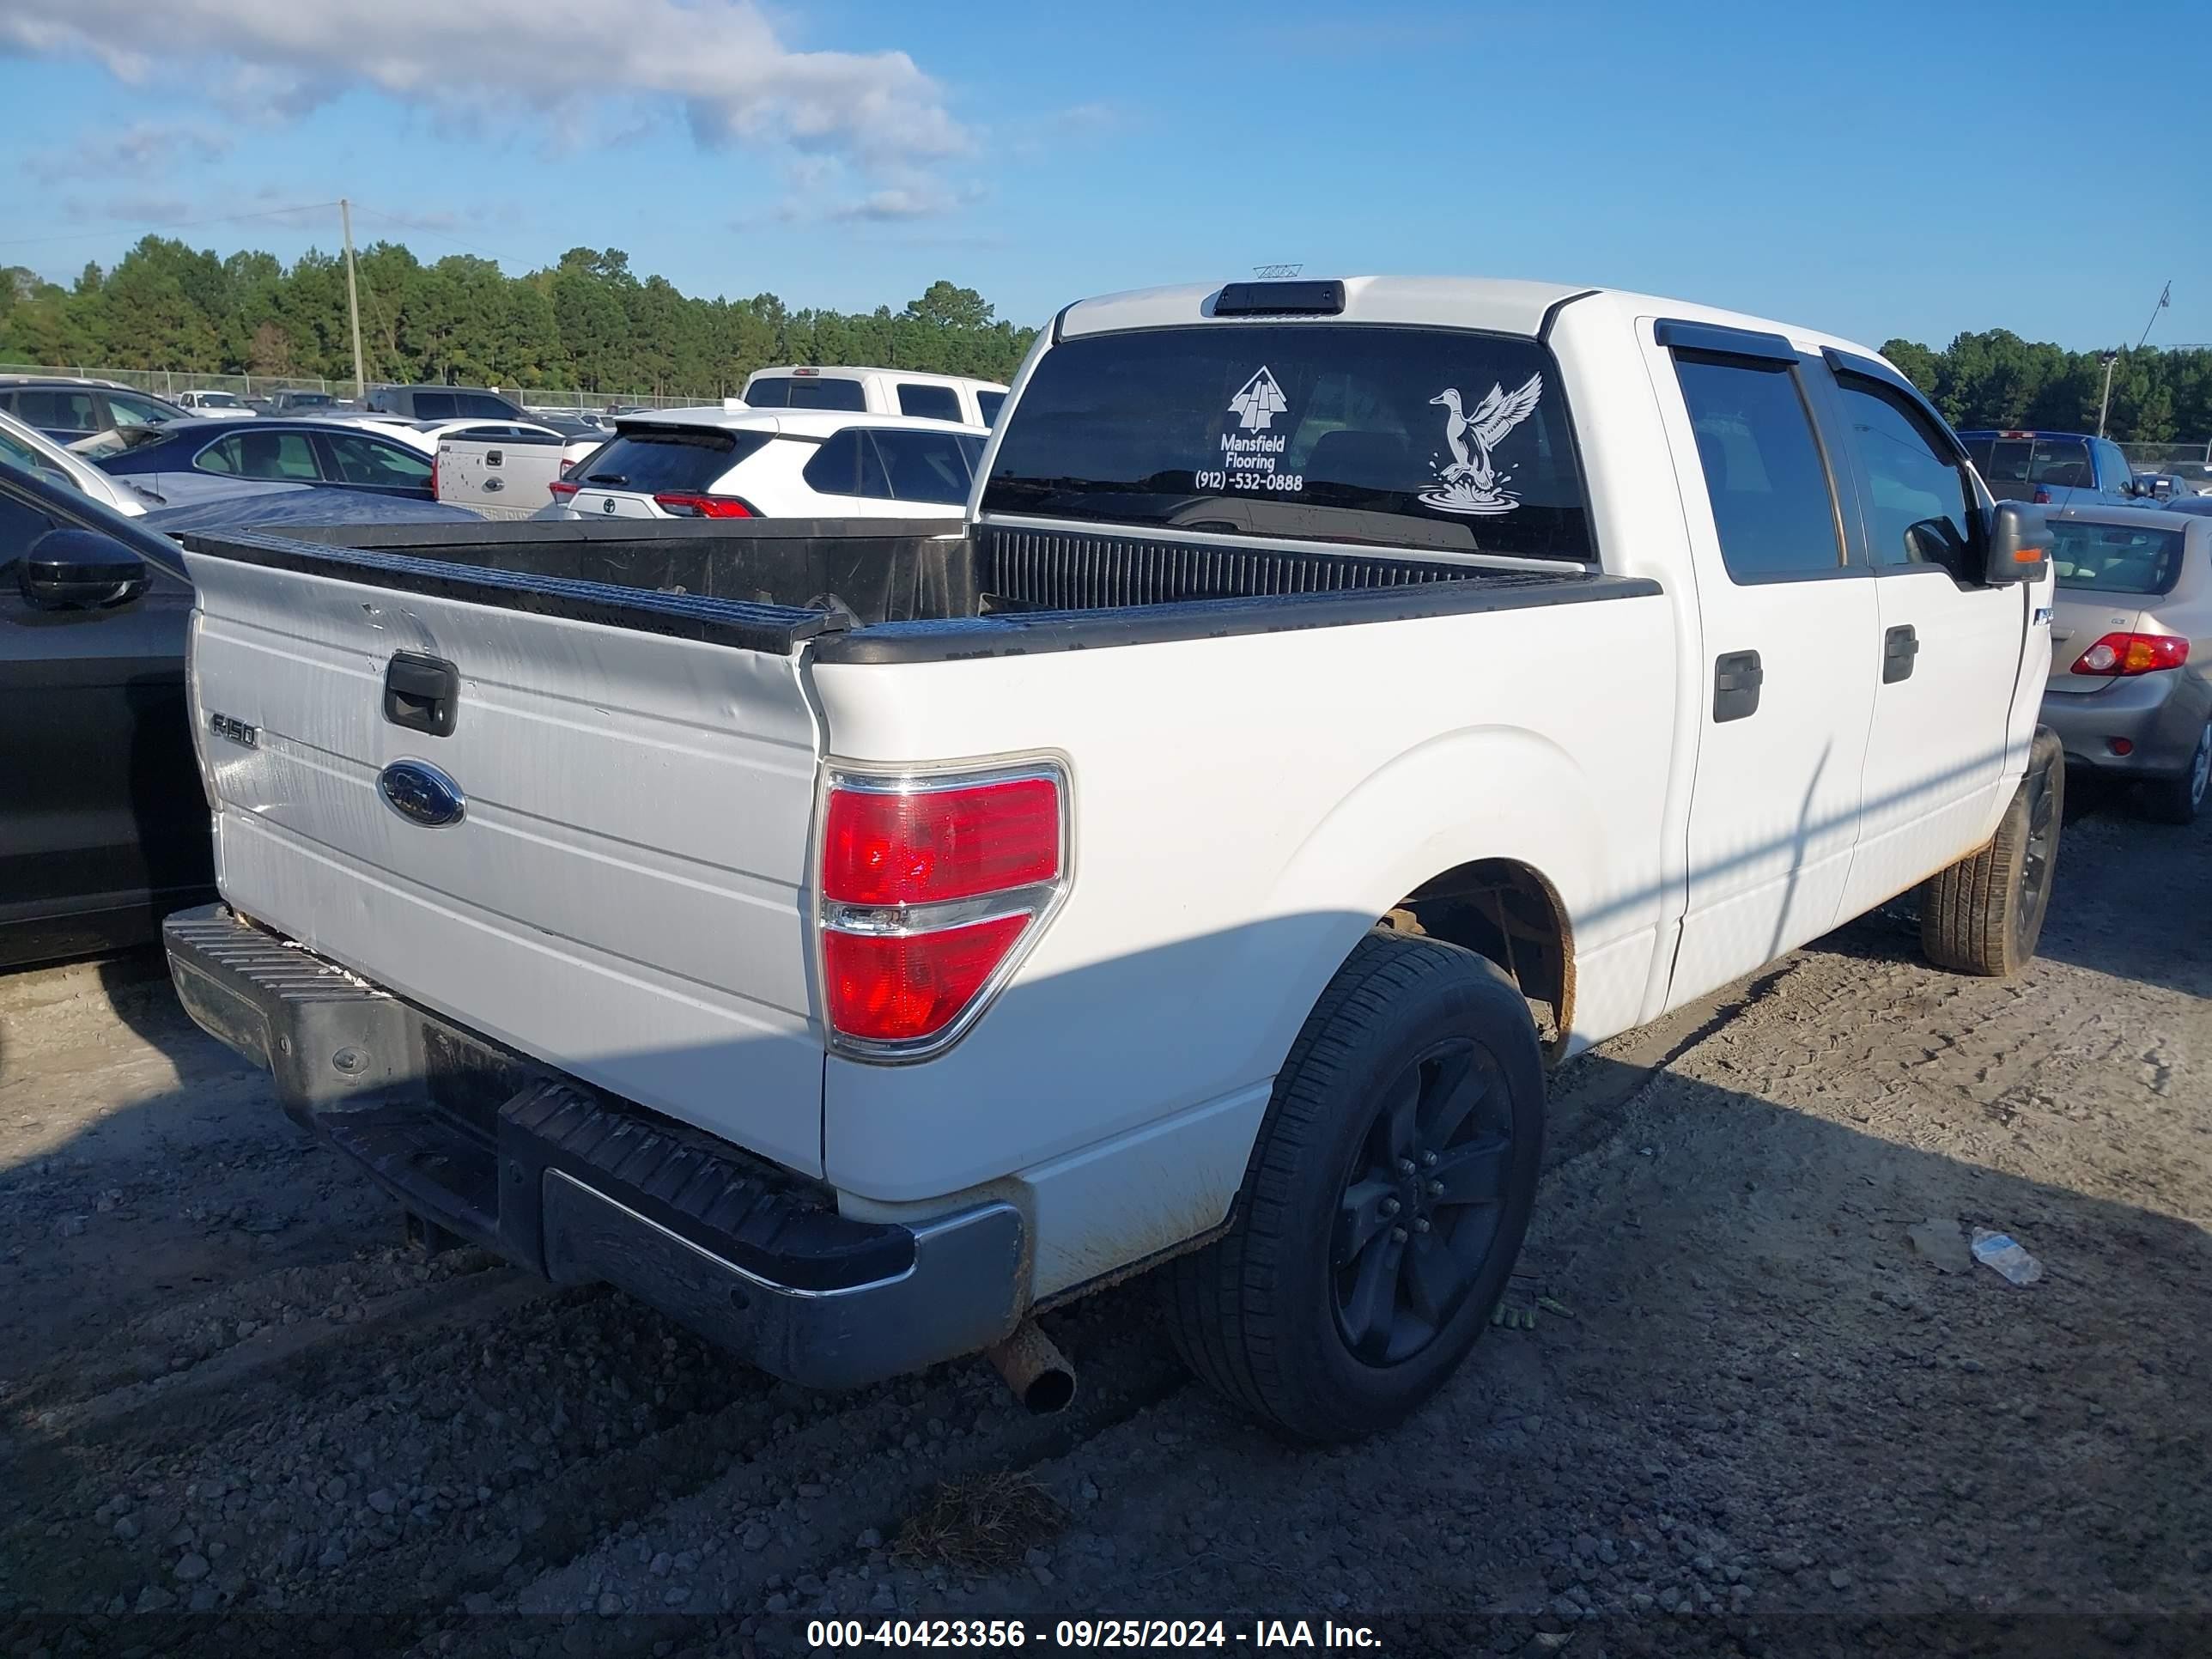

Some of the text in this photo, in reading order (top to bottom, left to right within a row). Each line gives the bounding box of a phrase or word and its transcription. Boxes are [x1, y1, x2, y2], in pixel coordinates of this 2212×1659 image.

[1220, 433, 1285, 453] Mansfield
[1224, 452, 1275, 473] Flooring
[1195, 470, 1304, 491] (912) -532-0888
